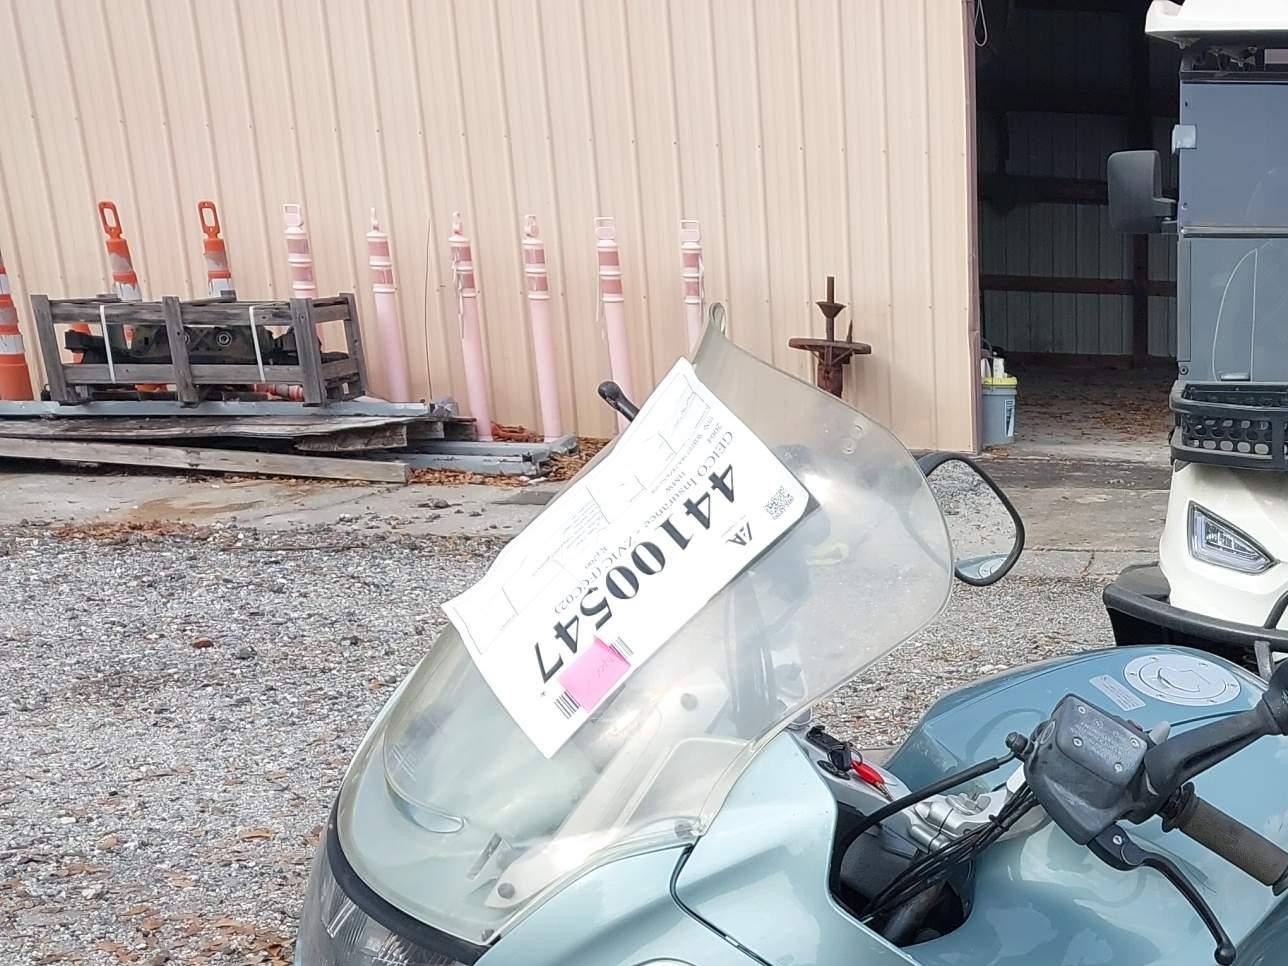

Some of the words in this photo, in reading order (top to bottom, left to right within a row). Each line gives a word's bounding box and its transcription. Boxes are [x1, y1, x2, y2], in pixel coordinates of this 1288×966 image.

[697, 432, 734, 476] GEICO
[644, 477, 697, 527] Insurance
[534, 464, 737, 683] 44100547
